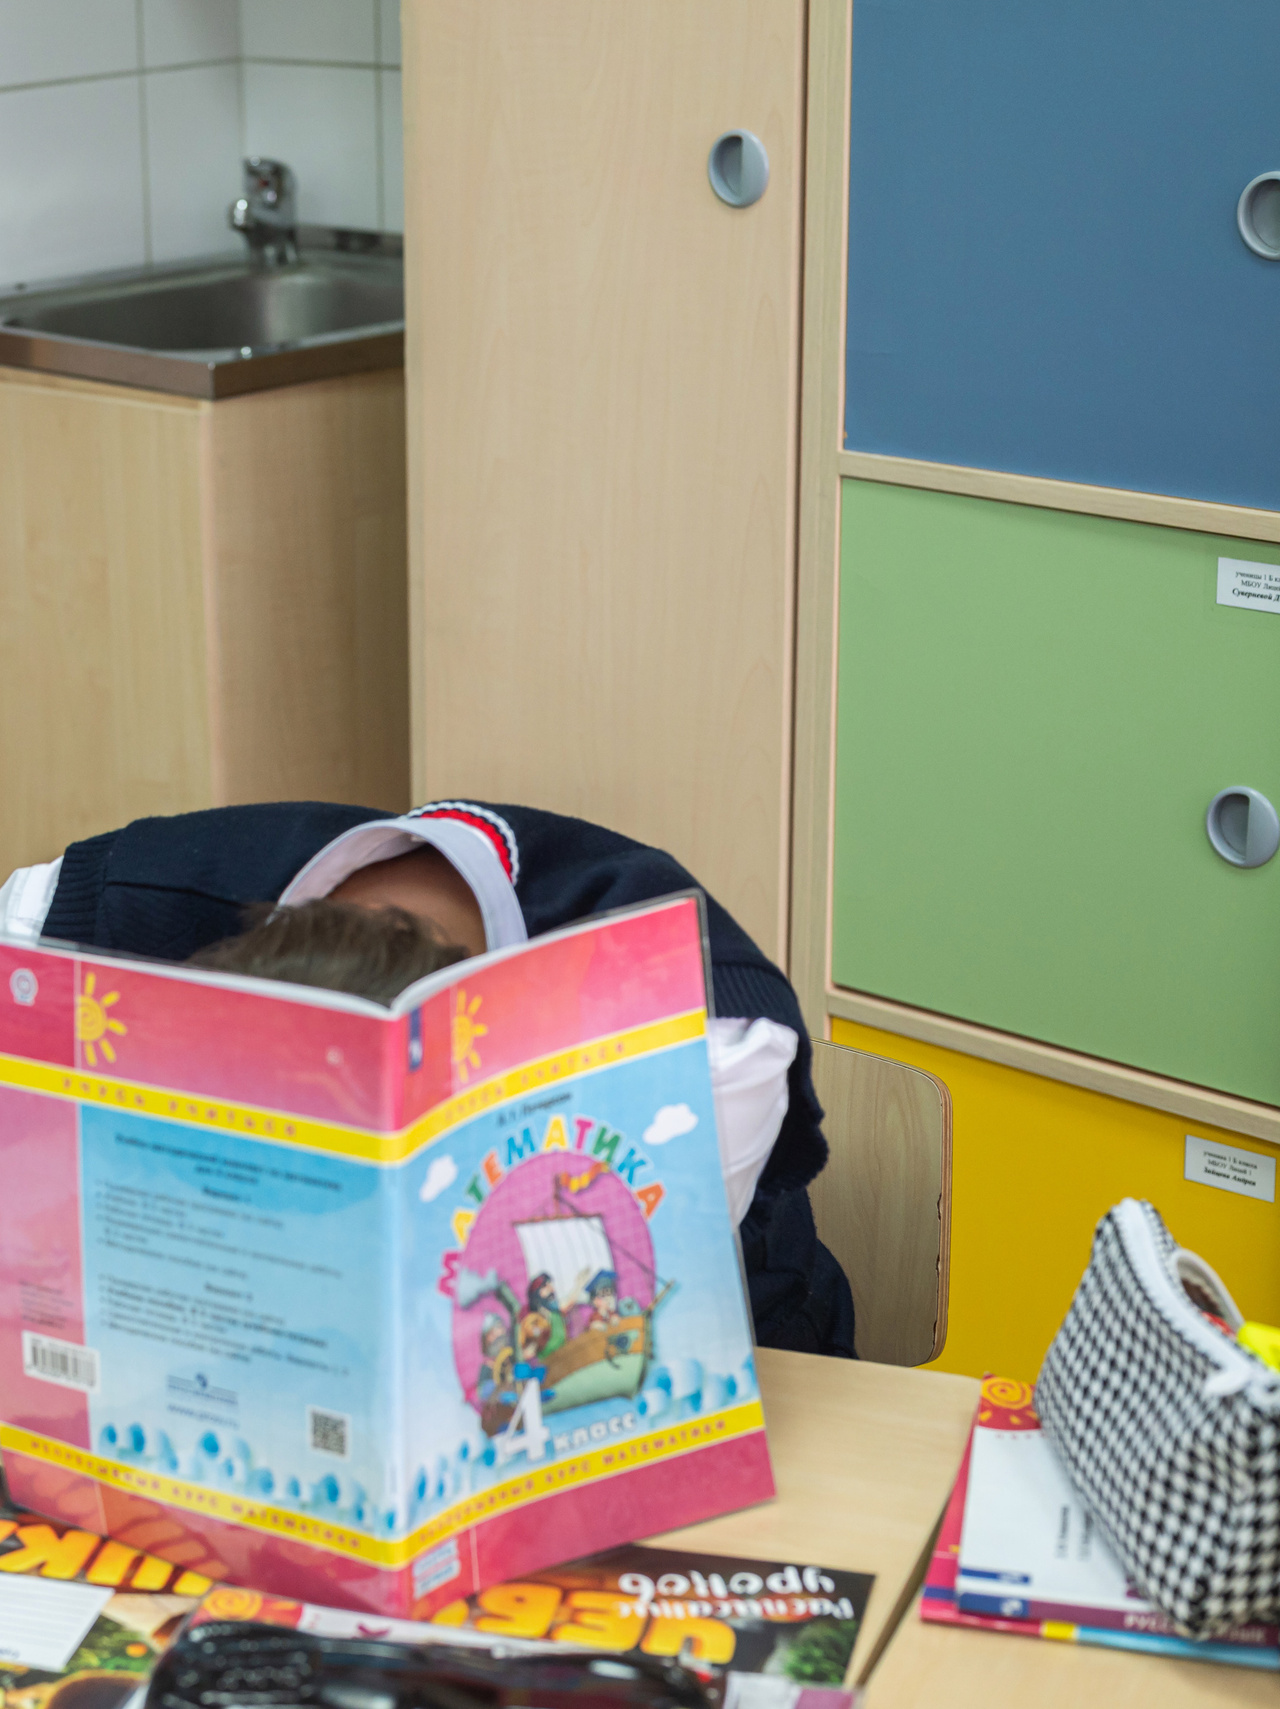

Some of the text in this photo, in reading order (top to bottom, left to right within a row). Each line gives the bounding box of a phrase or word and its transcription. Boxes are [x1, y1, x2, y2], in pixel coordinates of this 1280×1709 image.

[437, 1113, 666, 1298] МАТЕМАТИКА
[504, 1377, 637, 1462] 4 класс
[618, 1566, 835, 1601] уроков
